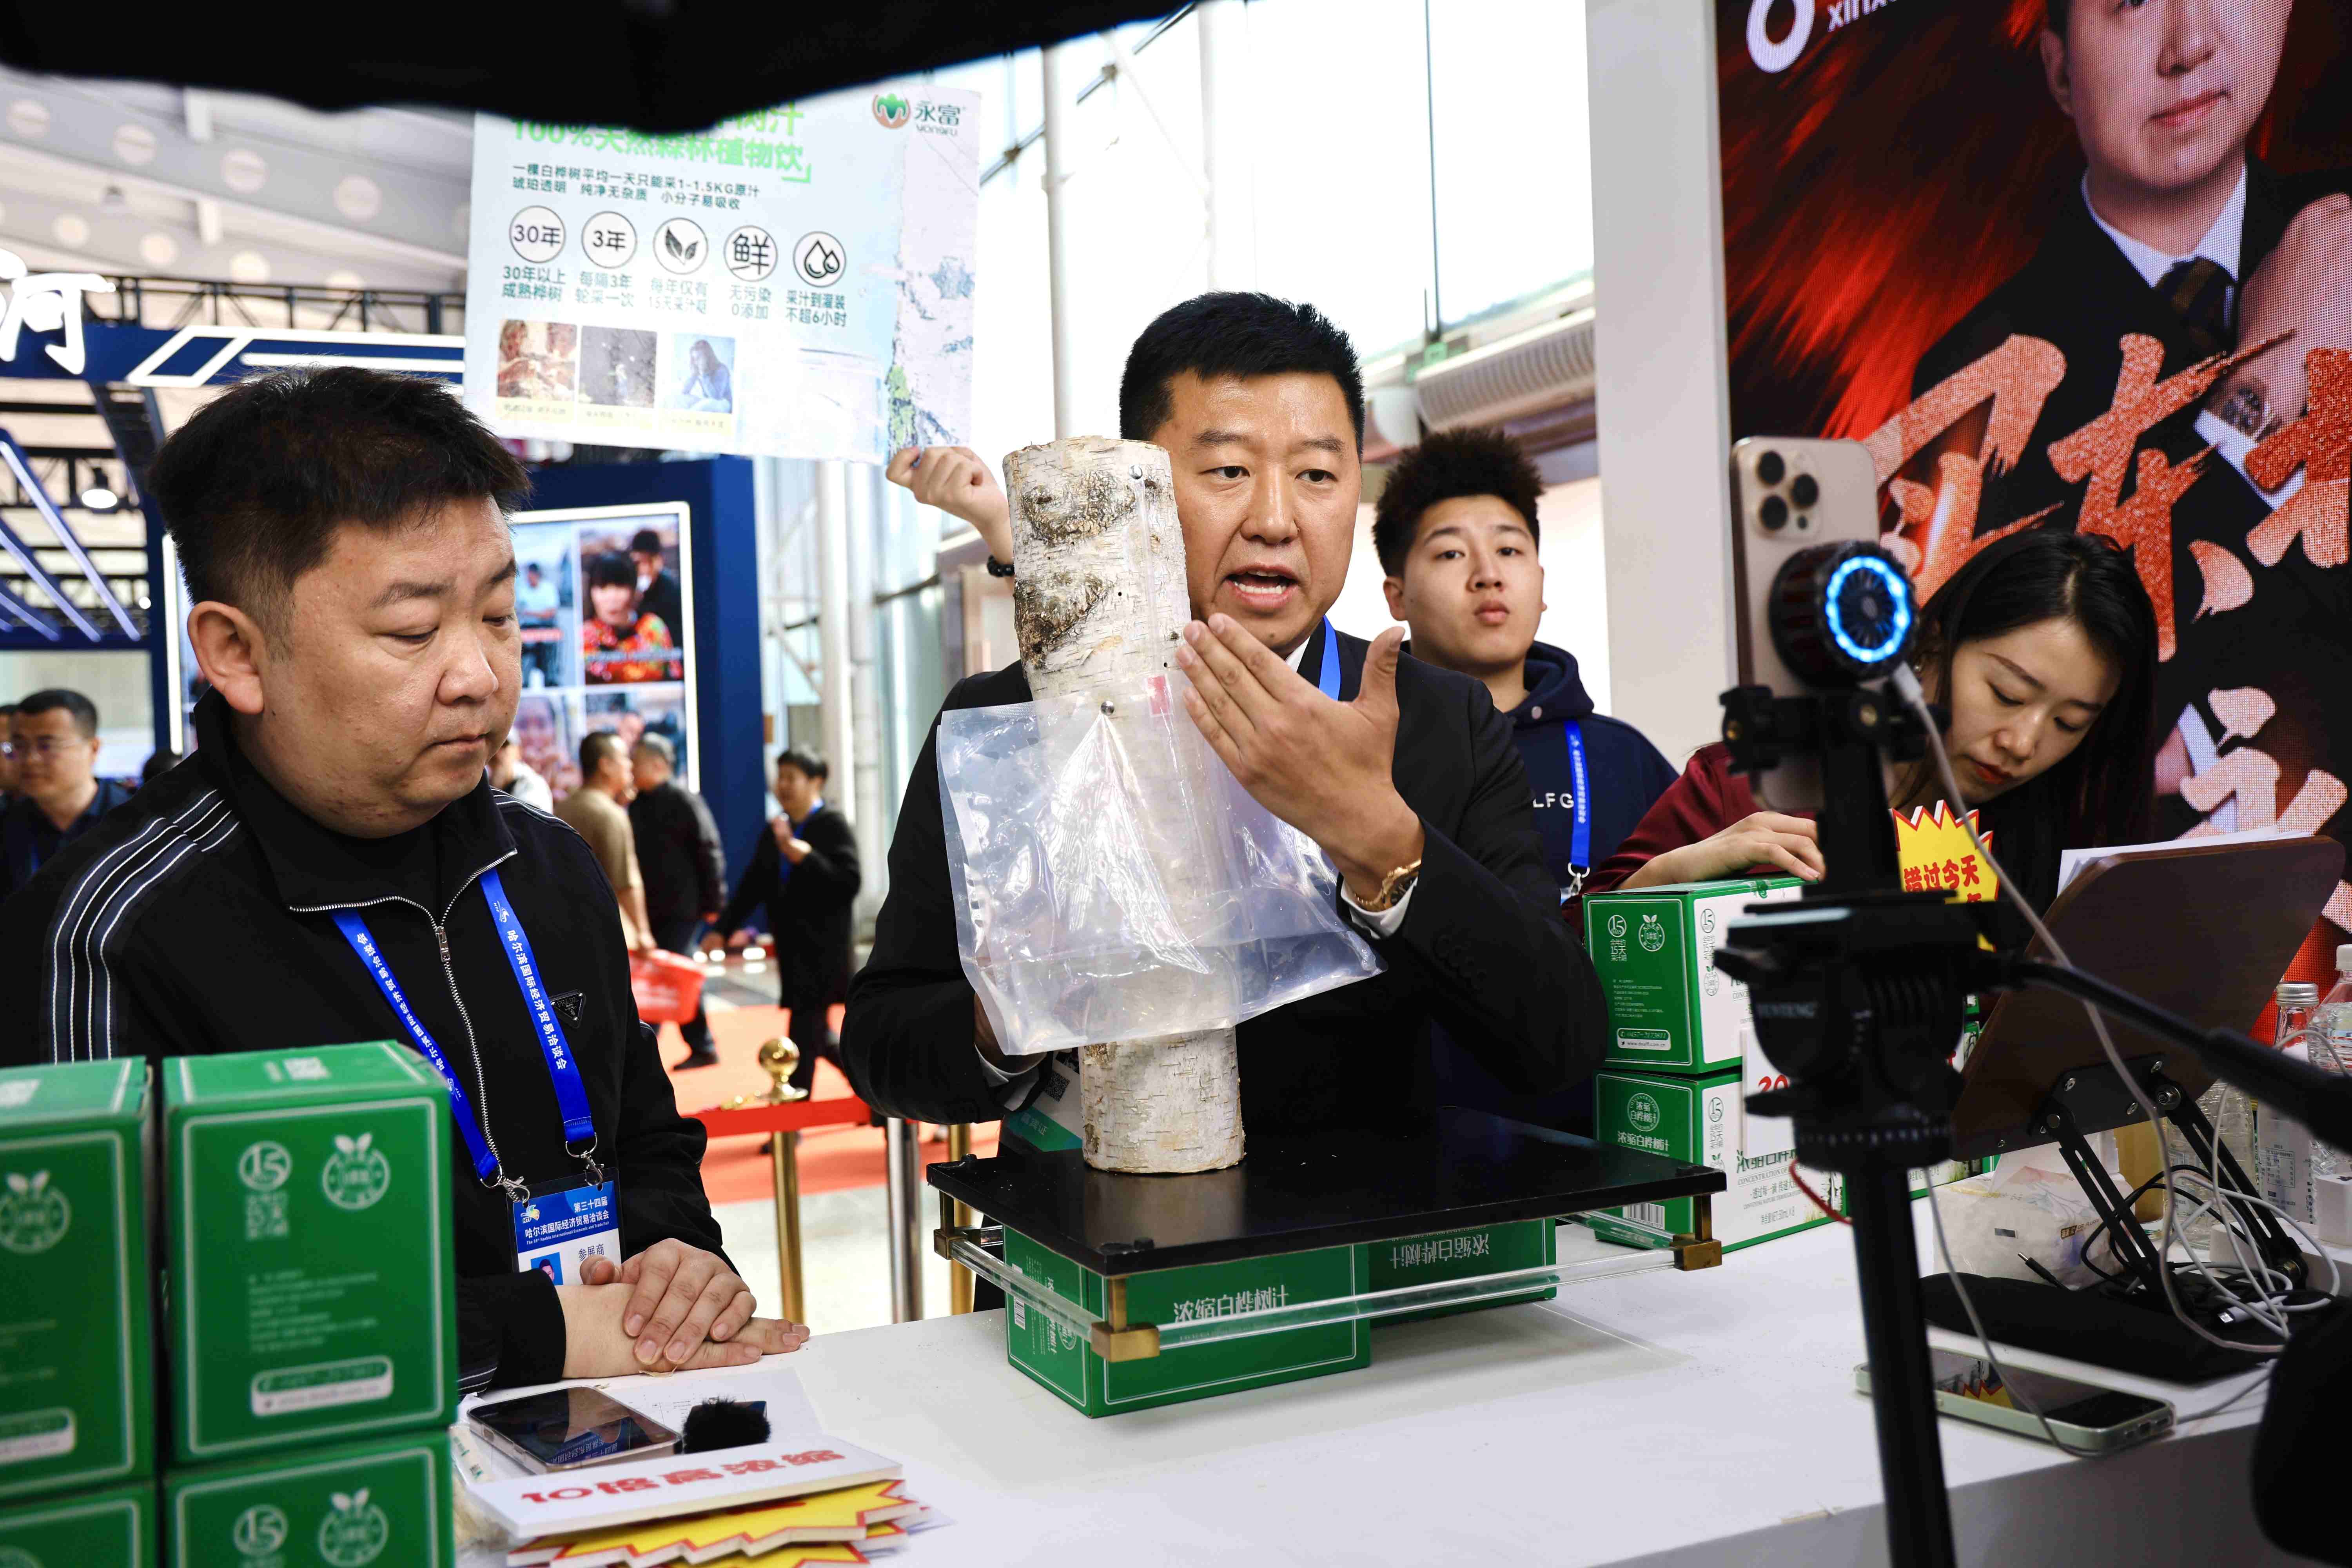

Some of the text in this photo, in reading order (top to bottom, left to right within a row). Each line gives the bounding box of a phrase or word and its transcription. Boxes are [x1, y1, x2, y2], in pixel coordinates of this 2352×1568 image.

[914, 100, 960, 125] 永富
[661, 191, 740, 210] 小分子易吸收
[514, 224, 561, 247] 30年
[592, 230, 626, 251] 3年
[730, 234, 770, 275] 鲜
[503, 265, 566, 285] 30年以上
[579, 270, 632, 289] 每隔3年
[729, 285, 771, 303] 无污染
[786, 289, 845, 310] 采汁到灌装
[731, 303, 769, 320] 0添加
[786, 307, 847, 327] 不超6小时
[1904, 855, 1980, 892] 错过今天
[357, 932, 445, 1071] 哈尔滨国际经济贸易洽谈会
[507, 930, 567, 1070] 哈尔滨国际经济贸易洽谈会
[1617, 1130, 1670, 1151] 浓缩白桦树汁
[573, 1196, 608, 1213] 第三十四届
[524, 1210, 610, 1239] 哈尔滨国际经济贸易洽谈会
[578, 1243, 604, 1261] 参展商
[1390, 1233, 1490, 1269] 浓缩白桦树汁
[1173, 1284, 1289, 1323] 浓缩白桦树汁
